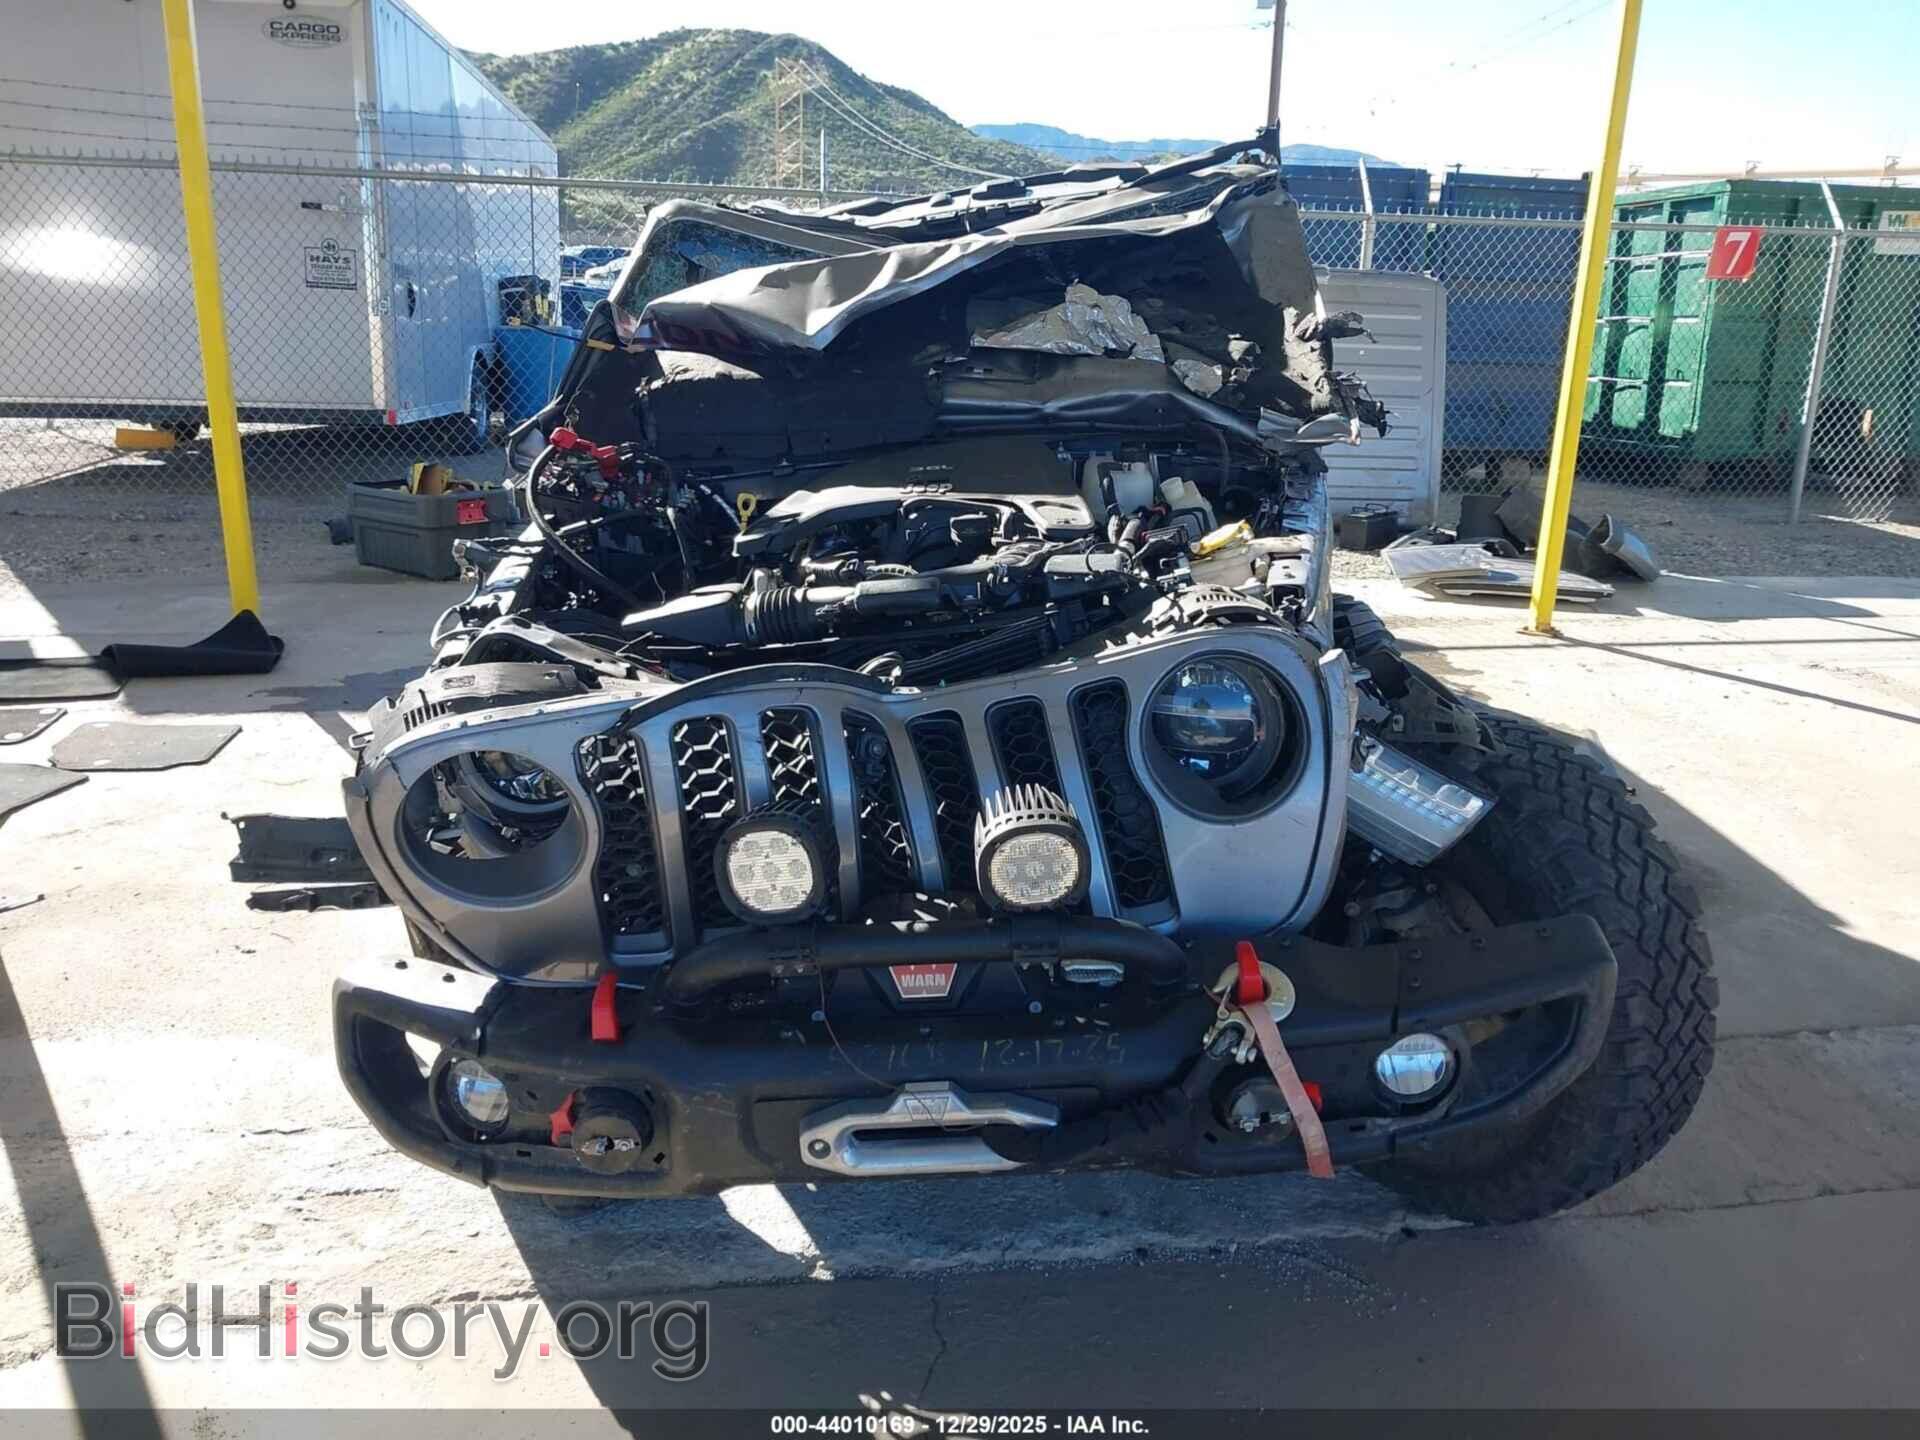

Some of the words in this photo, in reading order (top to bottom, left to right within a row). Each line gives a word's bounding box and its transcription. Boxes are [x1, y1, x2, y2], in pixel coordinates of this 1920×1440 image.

[270, 20, 341, 34] CARGO
[309, 254, 351, 264] HAYS
[1725, 231, 1752, 275] 7
[899, 482, 953, 495] Jeep
[901, 973, 945, 988] WARN
